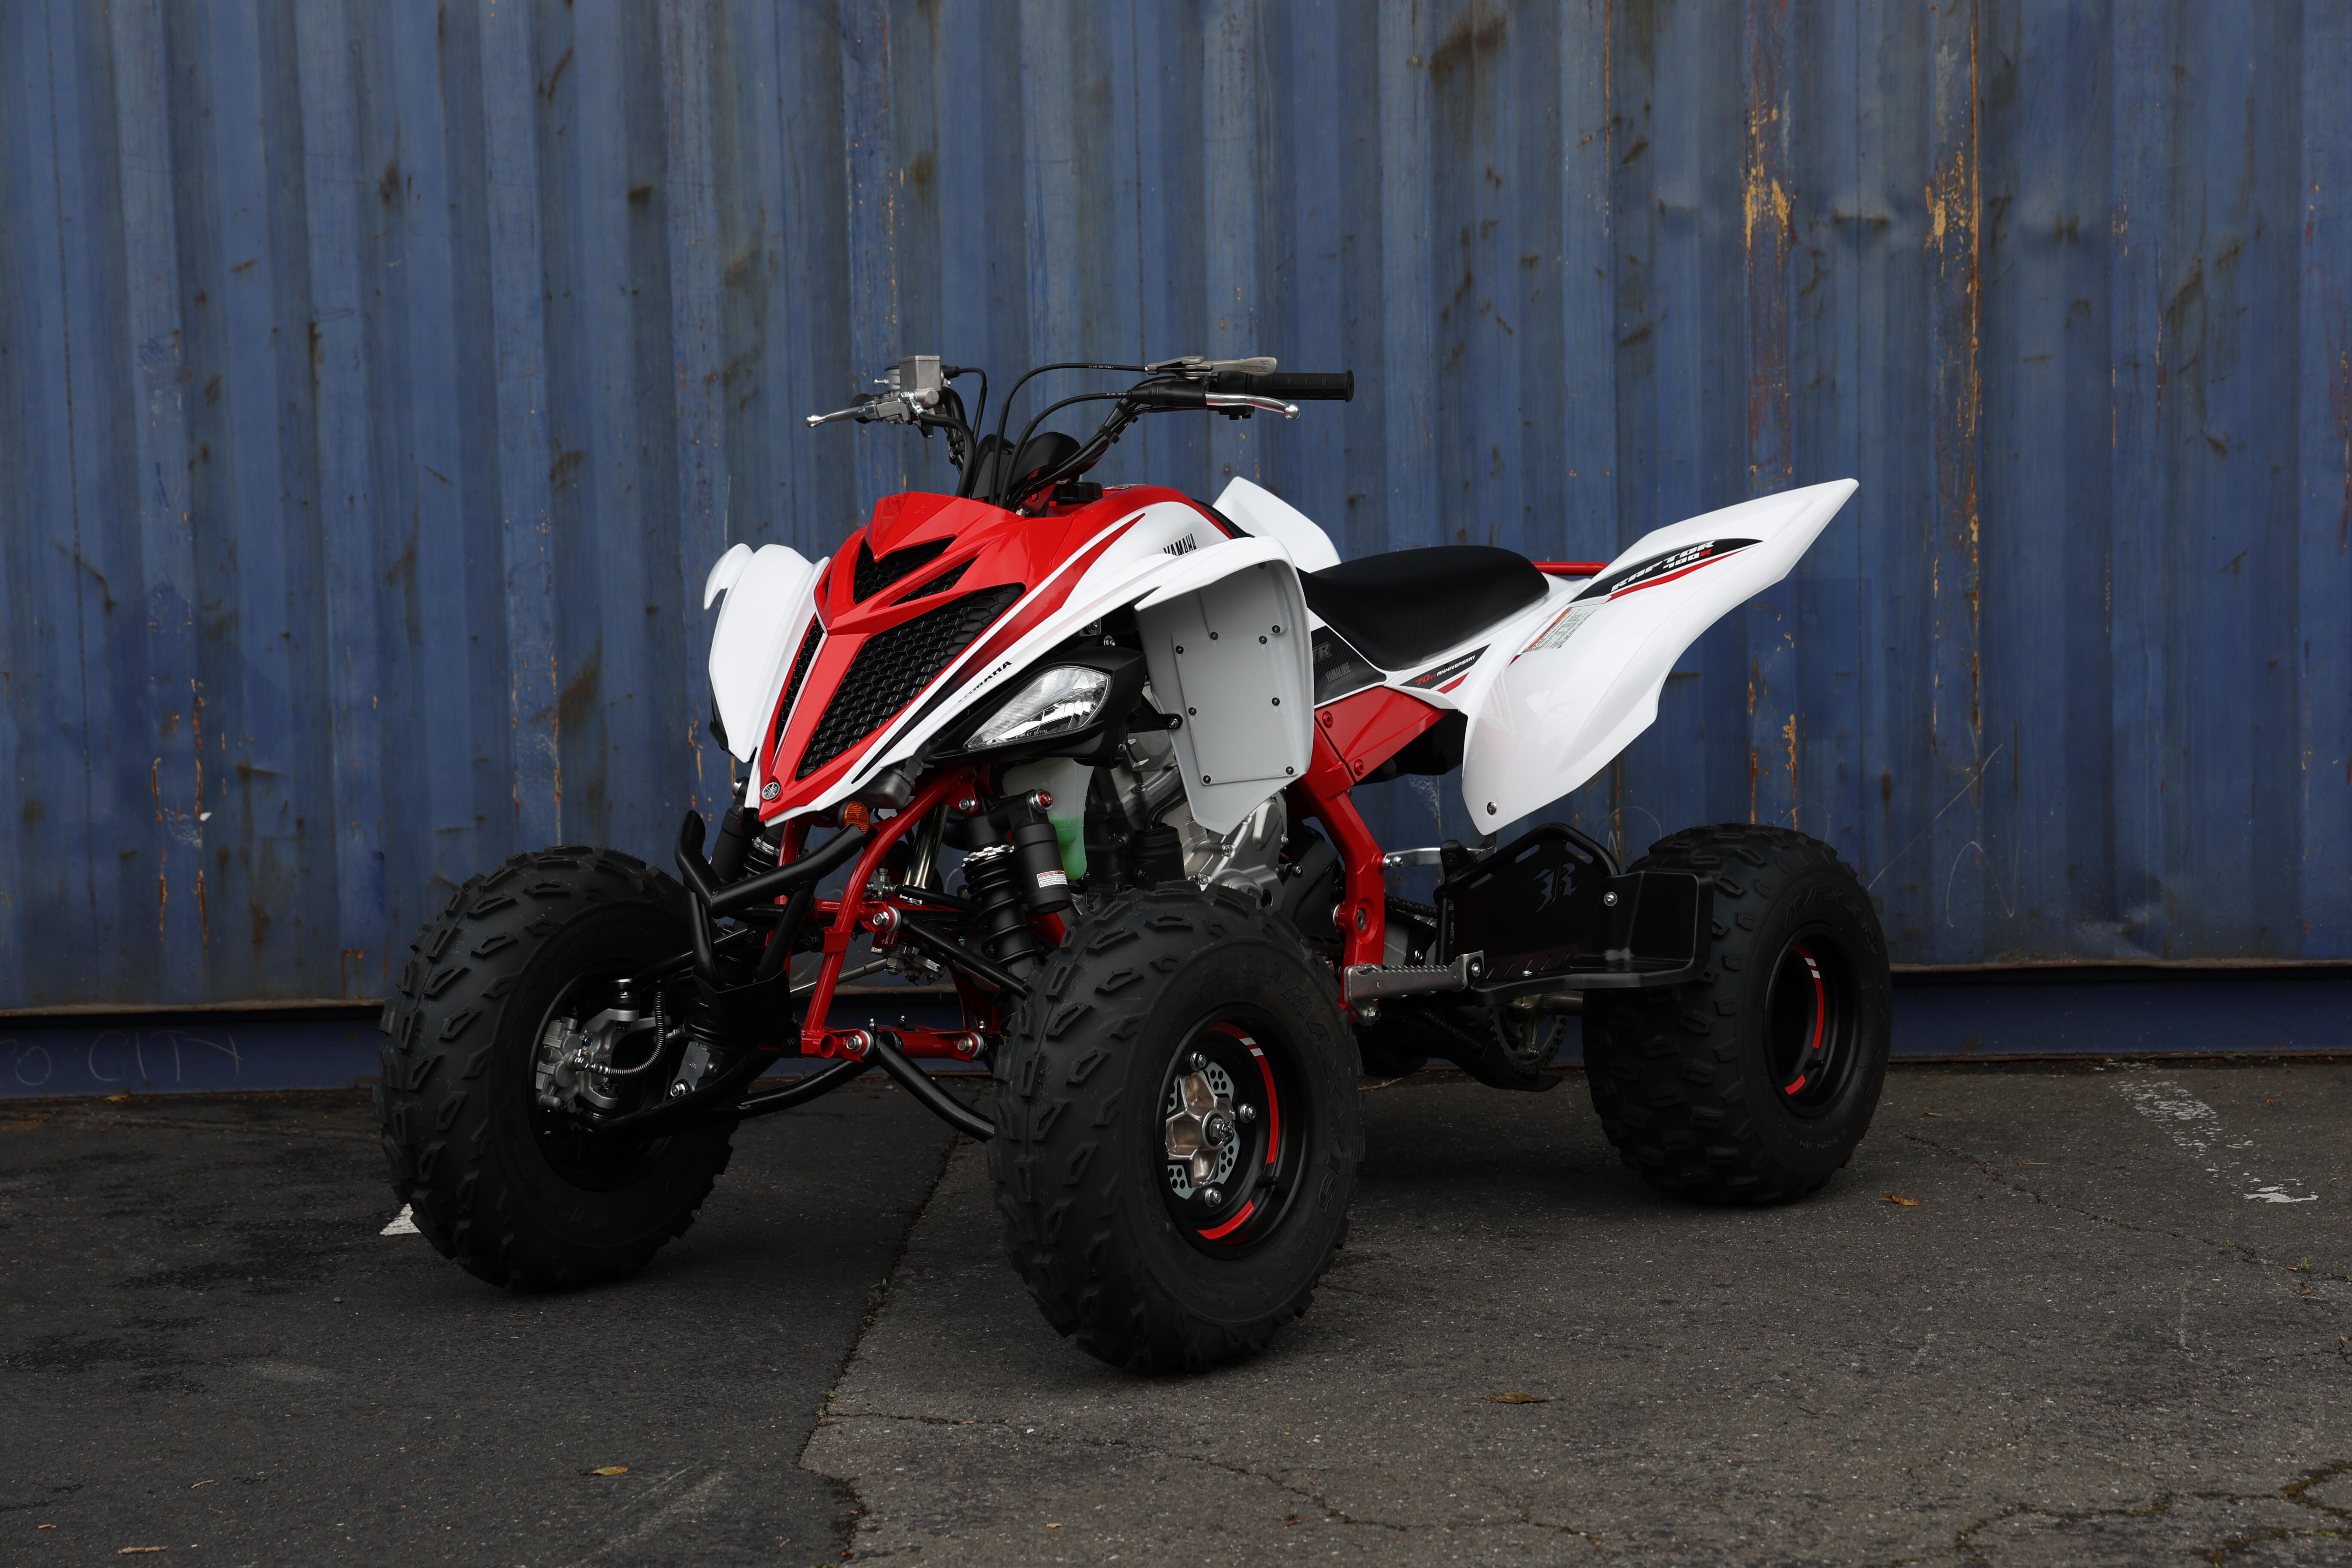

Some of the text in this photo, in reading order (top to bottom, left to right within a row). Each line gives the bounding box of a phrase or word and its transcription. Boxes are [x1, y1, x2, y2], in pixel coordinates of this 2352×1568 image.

[1611, 540, 1715, 592] RAPTOR
[1663, 548, 1712, 569] 700R
[1325, 662, 1352, 683] YAMALUBE
[1437, 655, 1476, 677] ANNIVERSARY
[1784, 884, 1878, 955] MAXXIS
[88, 1030, 243, 1082] CITY
[1280, 985, 1344, 1213] MAXXIS
